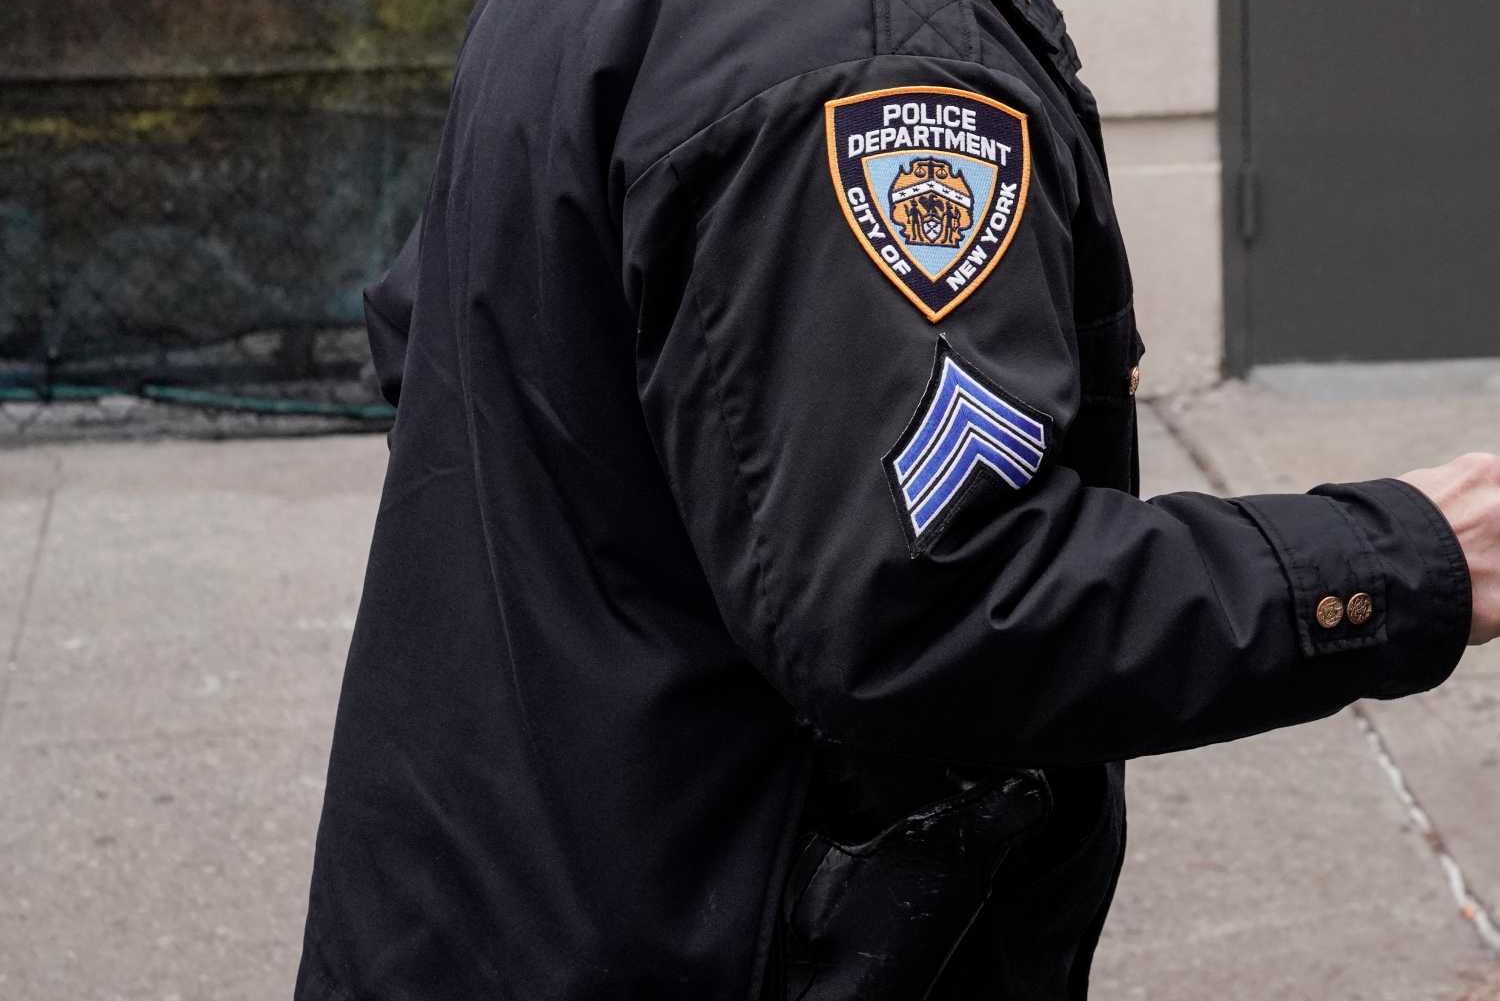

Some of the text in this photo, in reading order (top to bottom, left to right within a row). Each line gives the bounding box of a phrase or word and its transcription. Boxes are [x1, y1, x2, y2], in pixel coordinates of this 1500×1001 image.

[848, 125, 1012, 167] DEPARTMENT
[883, 103, 976, 132] POLICE
[847, 186, 911, 276] CITY OF
[945, 182, 1018, 292] NEW YORK
